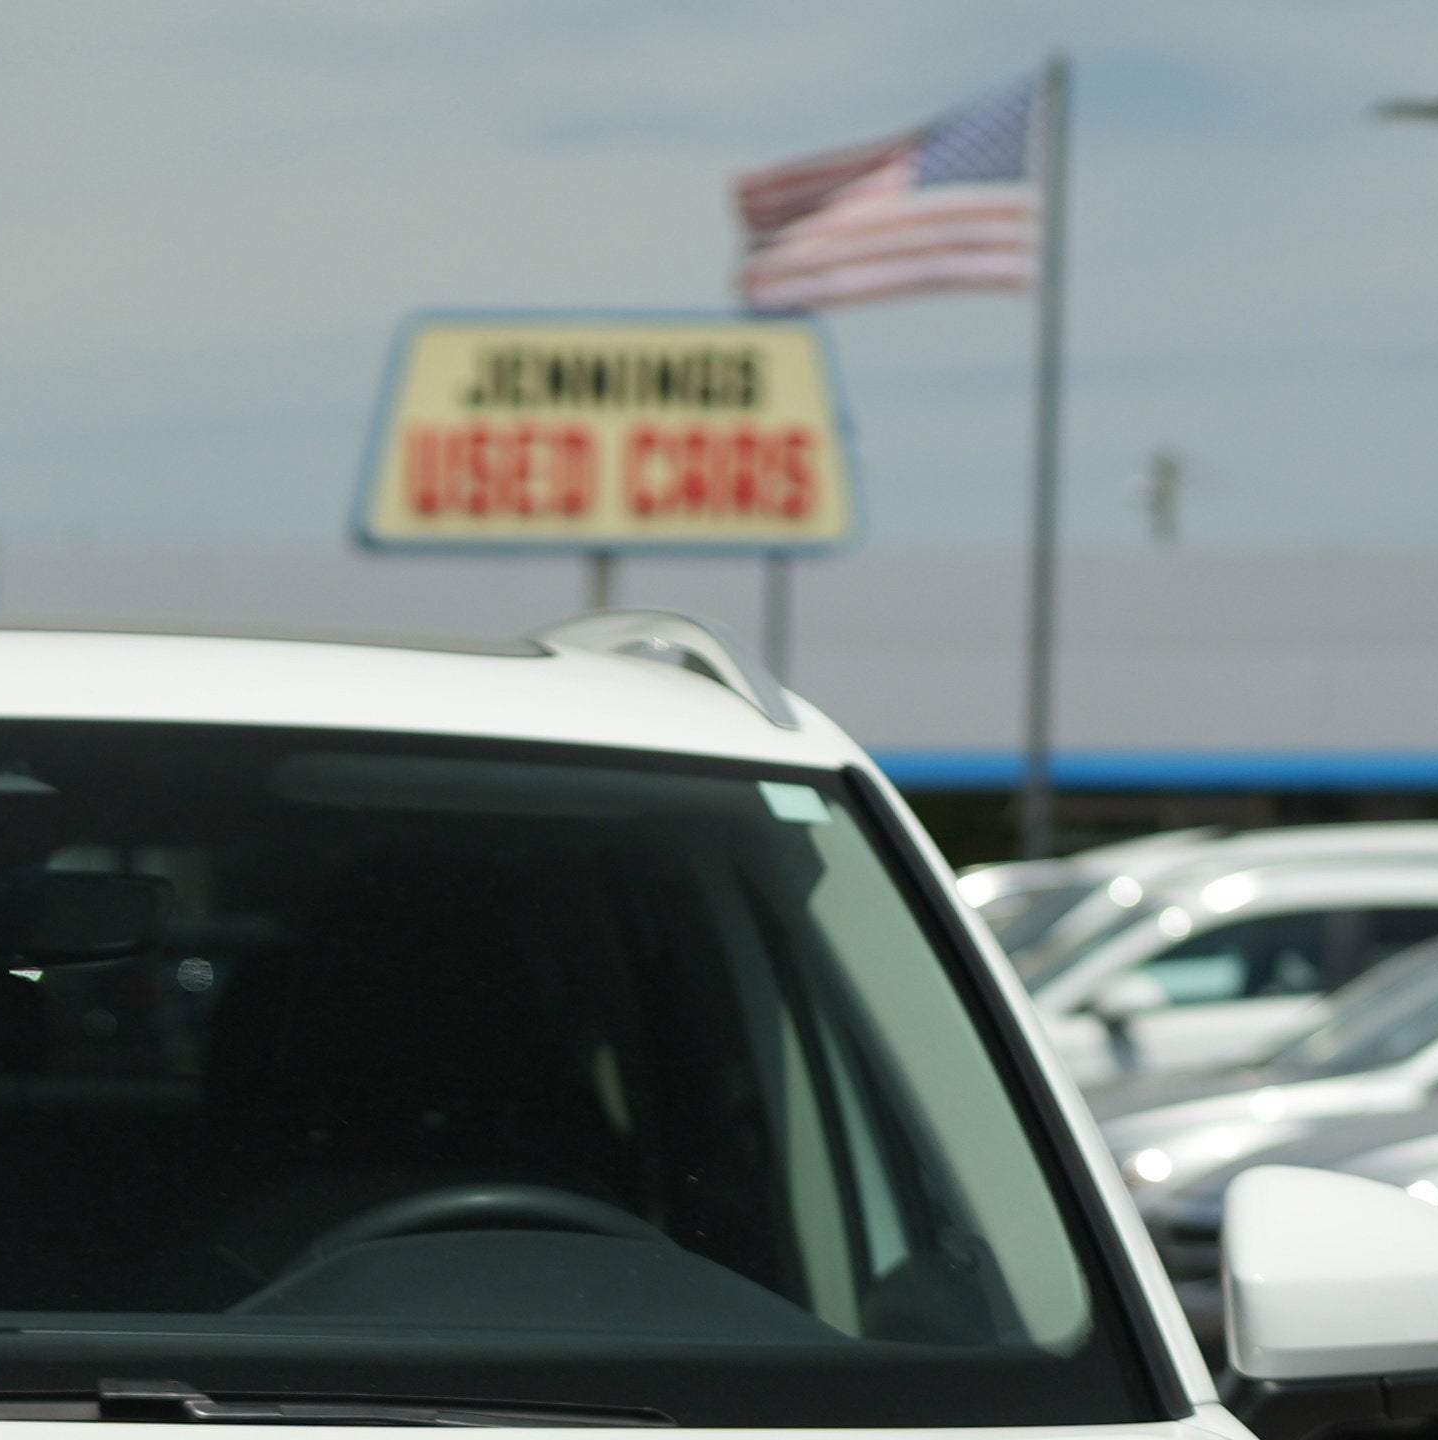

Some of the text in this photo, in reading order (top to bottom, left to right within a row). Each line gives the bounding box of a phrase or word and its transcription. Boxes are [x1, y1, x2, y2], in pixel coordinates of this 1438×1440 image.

[464, 350, 762, 407] JENNINGS
[405, 422, 814, 518] USED CARS
